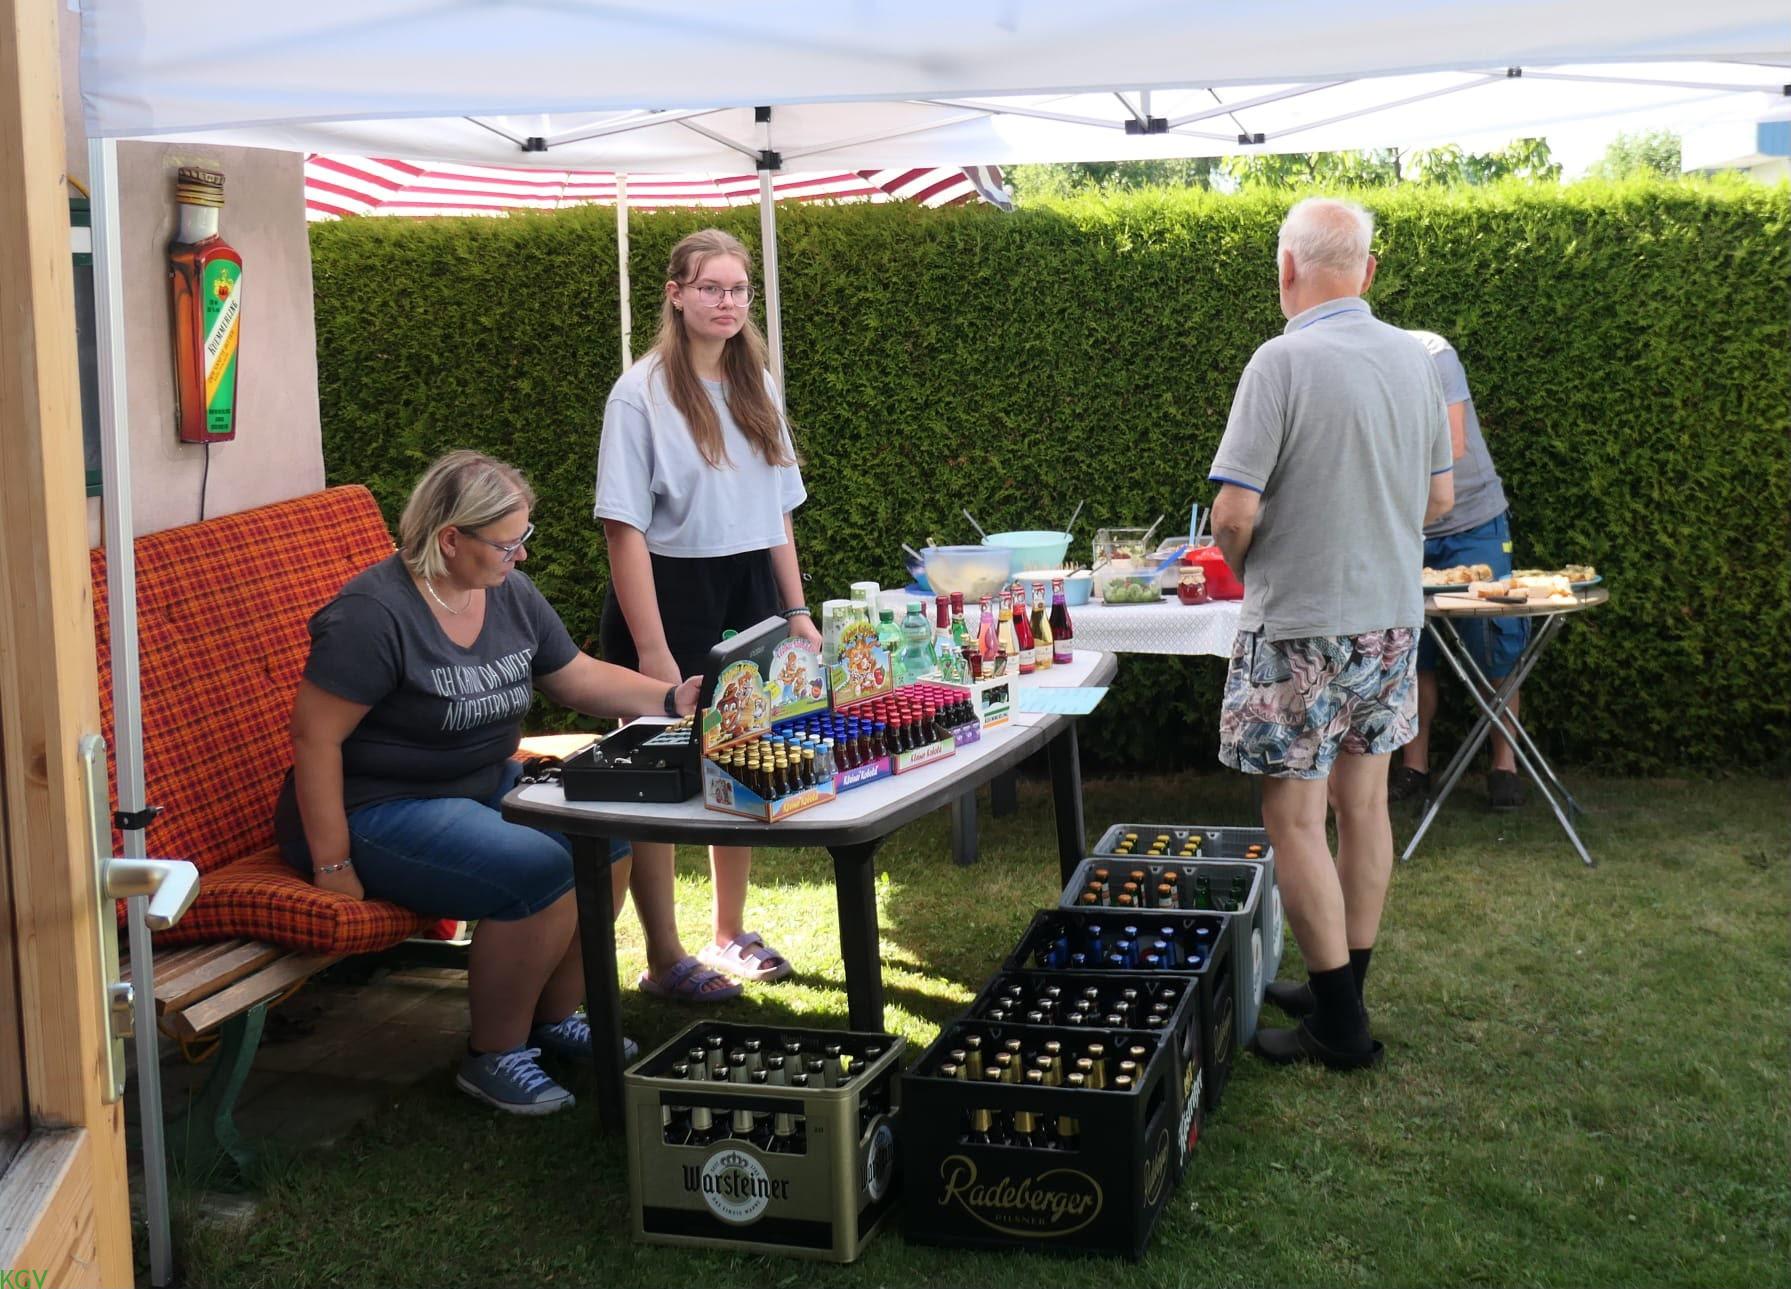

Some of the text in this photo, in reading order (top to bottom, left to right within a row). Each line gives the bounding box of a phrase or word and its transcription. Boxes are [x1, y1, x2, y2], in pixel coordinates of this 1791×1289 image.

[431, 667, 457, 696] ICH
[478, 663, 502, 690] DA
[496, 649, 532, 684] NICHT
[442, 684, 530, 731] NÜCHTERN HIN
[683, 1164, 790, 1200] Warsteiner
[938, 1155, 1103, 1236] Radeberger
